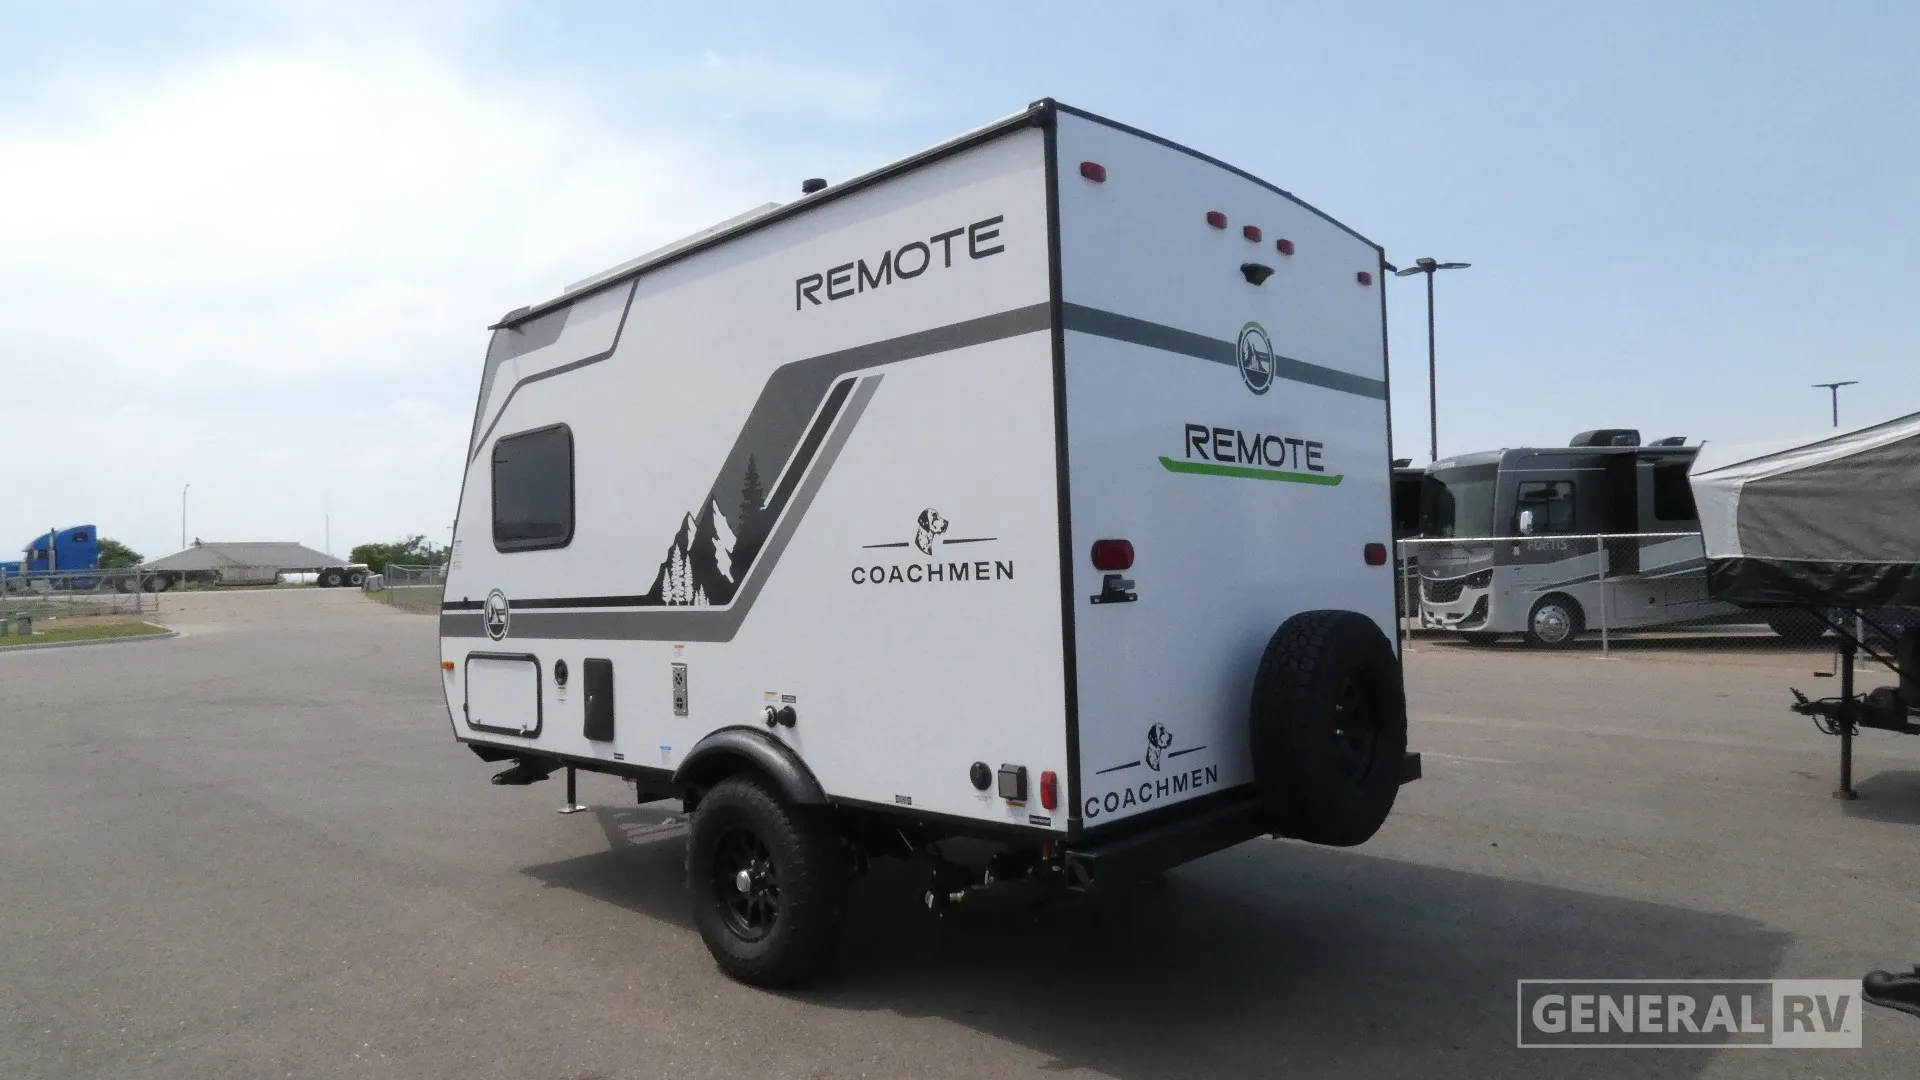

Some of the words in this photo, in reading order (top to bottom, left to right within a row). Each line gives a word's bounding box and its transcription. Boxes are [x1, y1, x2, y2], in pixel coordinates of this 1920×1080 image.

[796, 214, 1005, 311] REMOTE
[1185, 422, 1325, 472] REMOTE
[851, 560, 1014, 585] COACHMEN
[1084, 764, 1218, 818] COACHMEN
